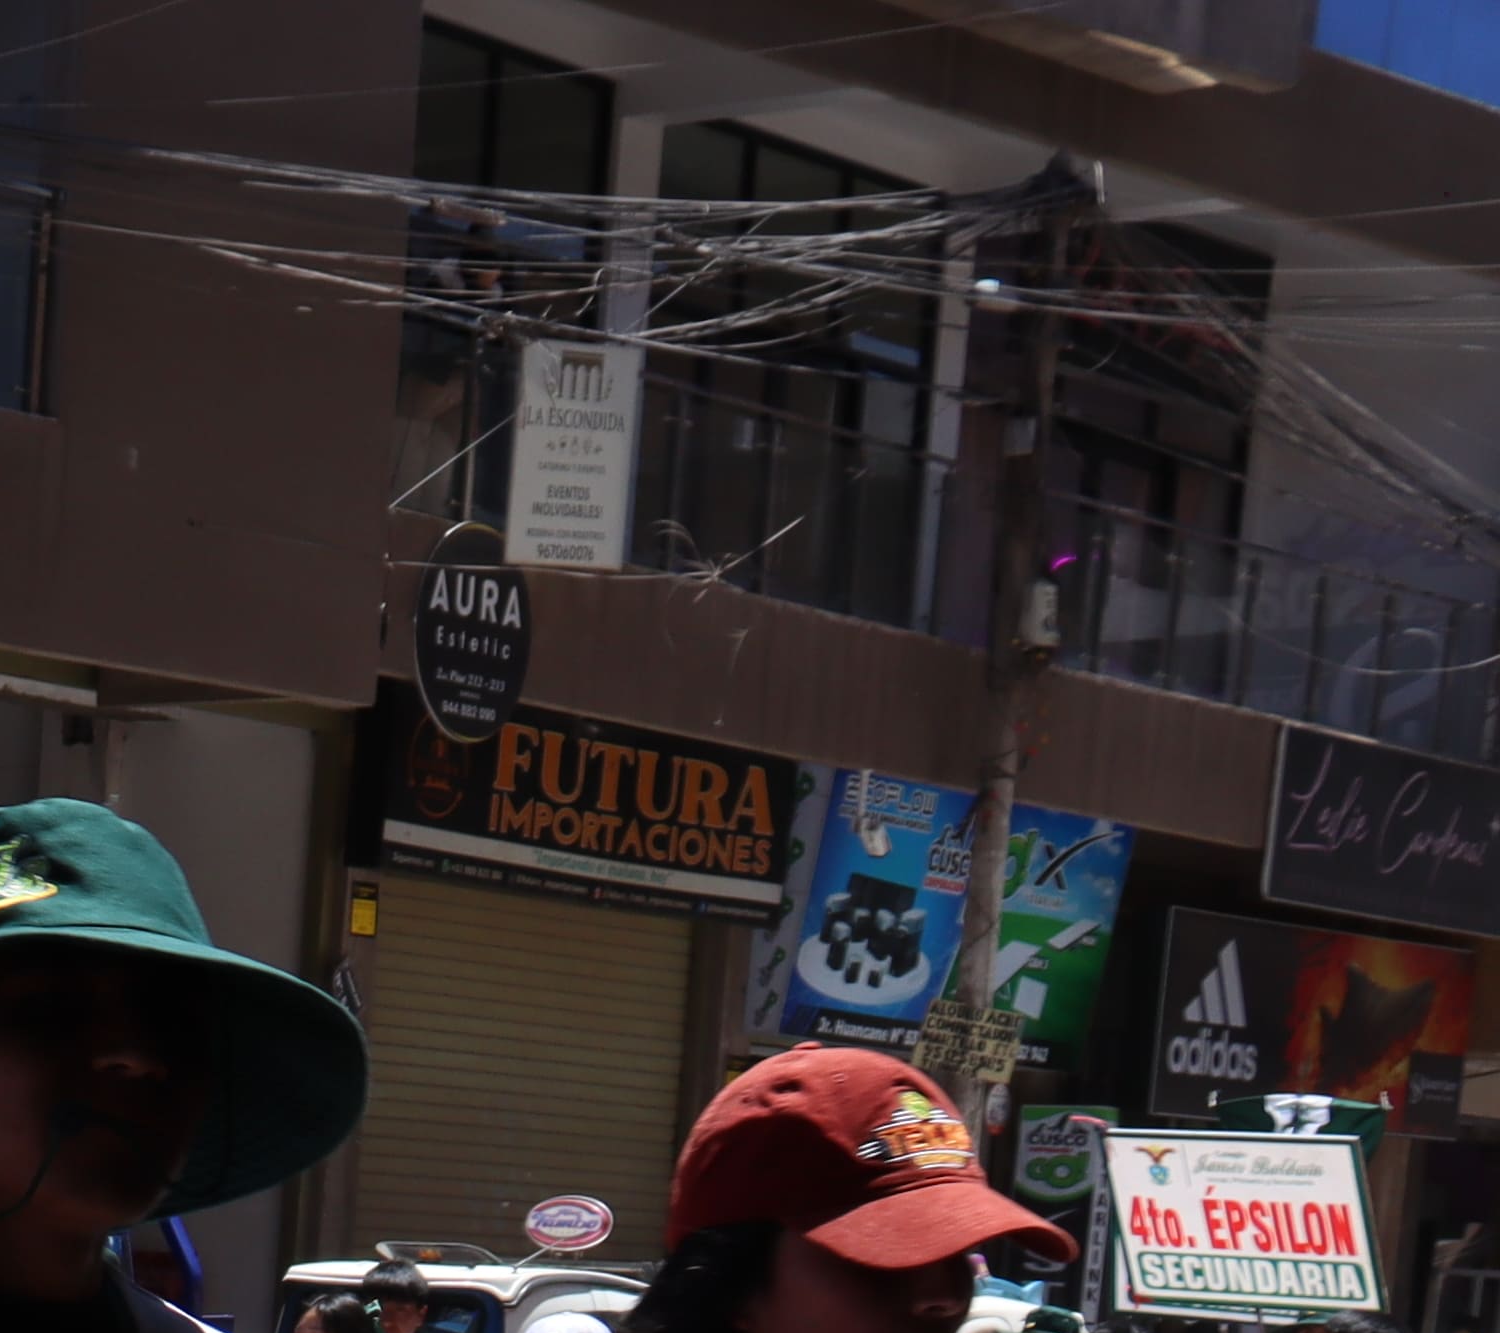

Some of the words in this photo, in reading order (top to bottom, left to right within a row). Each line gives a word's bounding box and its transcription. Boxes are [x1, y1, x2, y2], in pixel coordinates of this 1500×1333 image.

[428, 567, 522, 630] AURA
[493, 721, 775, 837] FUTURA
[487, 792, 772, 876] IMPORTACIONES
[1167, 1028, 1259, 1083] adidas
[1129, 1195, 1195, 1249] 4to.
[1202, 1186, 1359, 1257] ÉPSILON
[1140, 1252, 1365, 1300] SECUNDARIA
